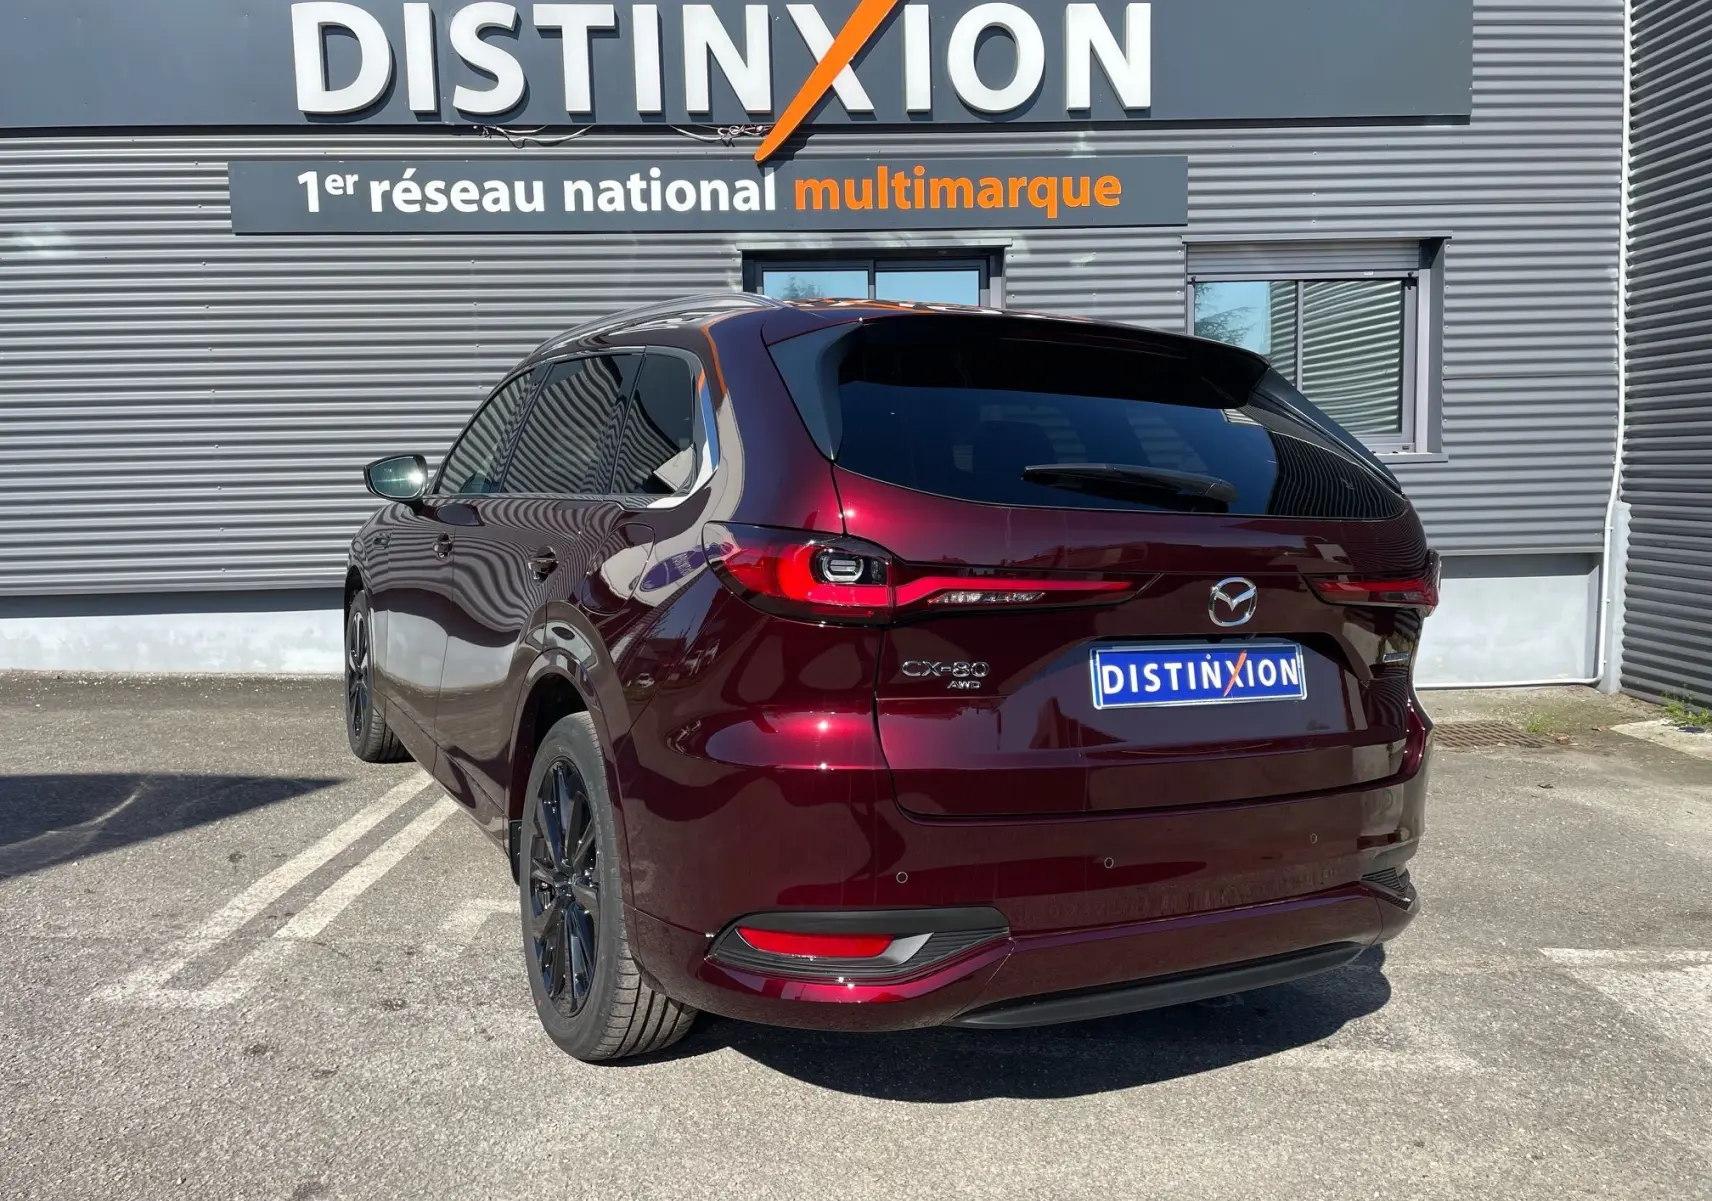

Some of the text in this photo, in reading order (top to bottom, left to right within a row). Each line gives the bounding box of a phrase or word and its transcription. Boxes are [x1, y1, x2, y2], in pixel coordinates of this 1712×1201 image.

[290, 0, 1152, 163] DISTINXION
[297, 165, 1123, 219] 1er réseau national multimarque
[901, 660, 990, 678] CX-80
[947, 680, 982, 689] AWD
[1101, 650, 1300, 697] DISTINXION
